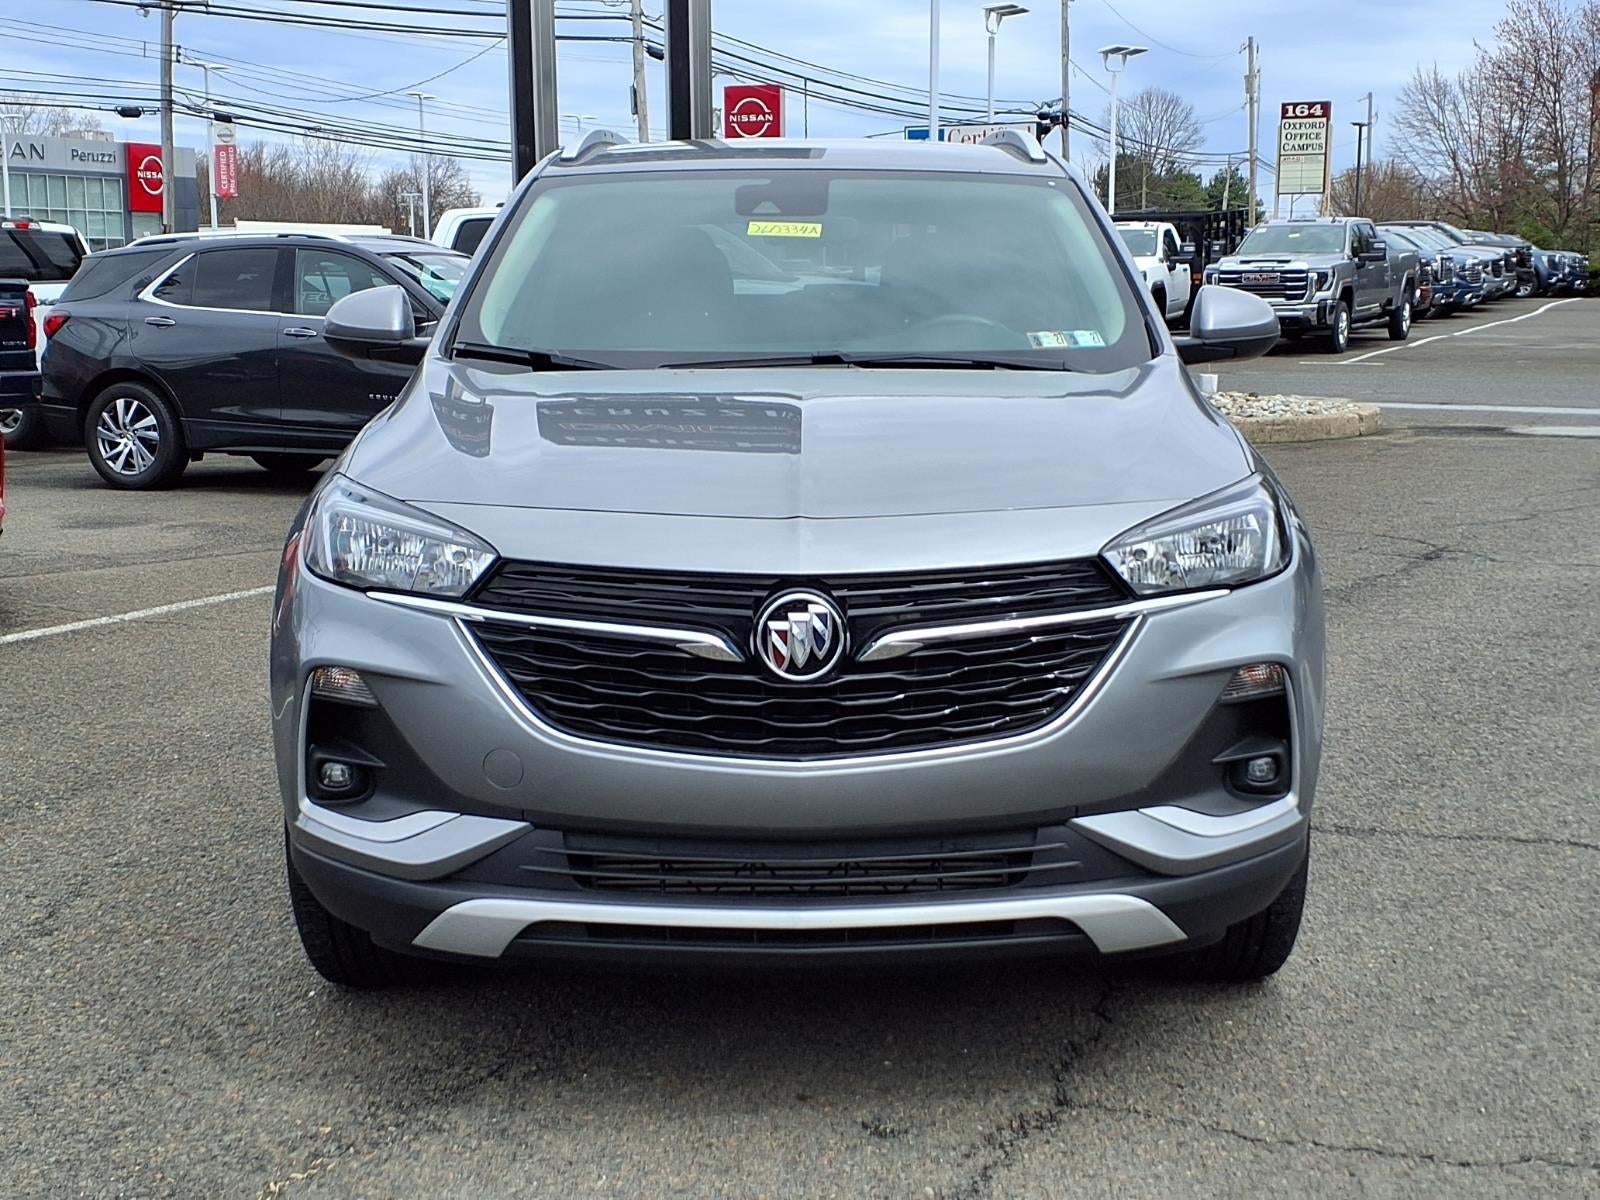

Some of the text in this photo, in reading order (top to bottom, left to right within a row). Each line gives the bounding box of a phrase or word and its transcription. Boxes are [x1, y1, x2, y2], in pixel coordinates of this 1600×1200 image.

[1285, 103, 1324, 117] 164
[729, 114, 773, 122] NISSAN
[1283, 121, 1325, 131] OXFORD
[1285, 132, 1322, 141] OFFICE
[0, 141, 116, 163] AN Peruzzi
[1282, 142, 1324, 152] CAMPUS
[137, 170, 163, 179] NISSA
[219, 150, 228, 189] CERTIFIED
